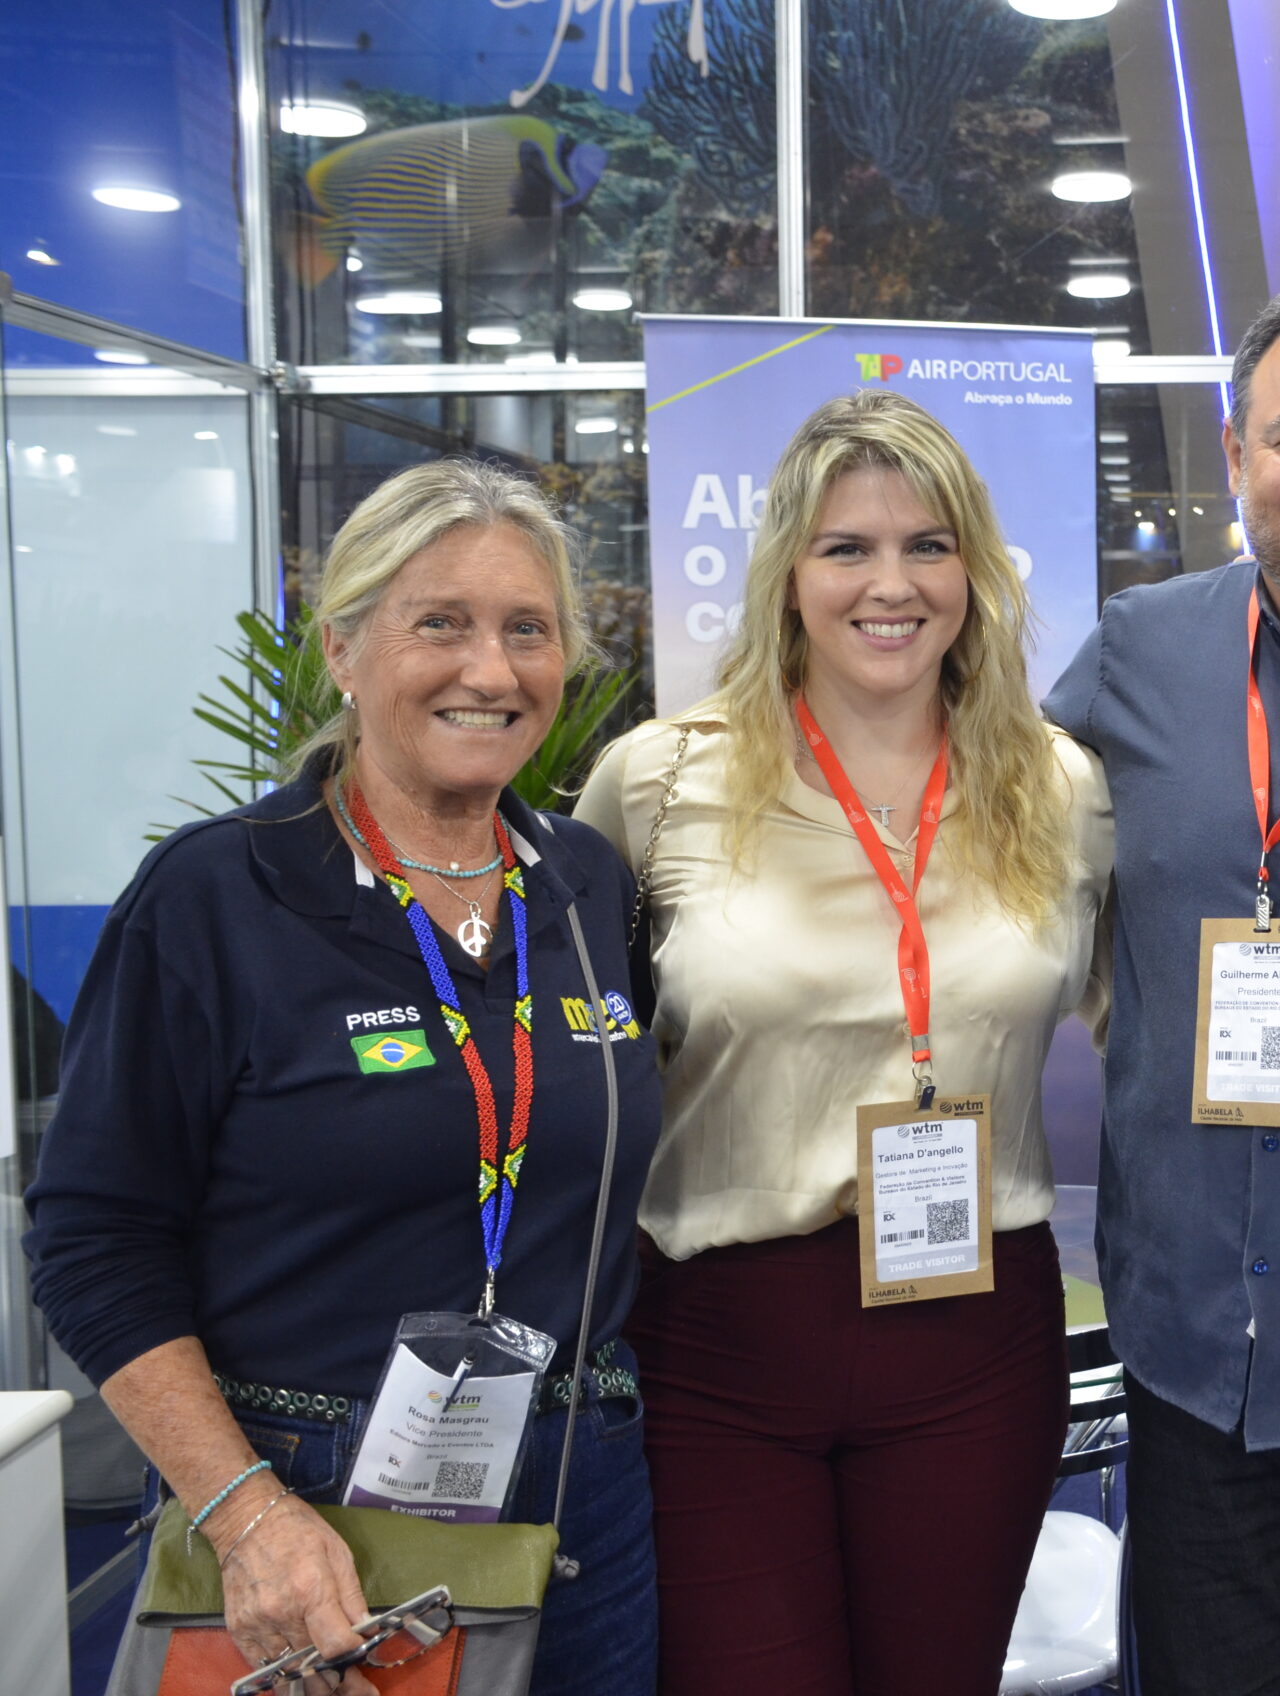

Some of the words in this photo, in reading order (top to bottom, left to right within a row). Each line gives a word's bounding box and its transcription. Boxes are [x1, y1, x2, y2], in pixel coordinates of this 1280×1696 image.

[855, 353, 903, 382] TAP
[964, 391, 1012, 406] Abraça
[1016, 395, 1023, 404] o
[1027, 392, 1073, 405] Mundo
[684, 545, 727, 587] o
[1220, 970, 1269, 979] Guilherme
[346, 1006, 421, 1030] PRESS
[954, 1100, 983, 1111] wtm
[1198, 1107, 1233, 1116] ILHABELA
[912, 1122, 942, 1135] wtm
[878, 1152, 914, 1163] Tatiana
[917, 1146, 964, 1158] D'angello
[888, 1261, 922, 1273] TRADE
[925, 1254, 965, 1268] VISITOR
[869, 1287, 906, 1299] ILHABELA
[408, 1406, 435, 1423] Rosa
[439, 1416, 489, 1425] Masgrau
[407, 1422, 426, 1436] Vice
[428, 1430, 483, 1438] Presidente
[391, 1504, 457, 1517] EXHIBITOR
